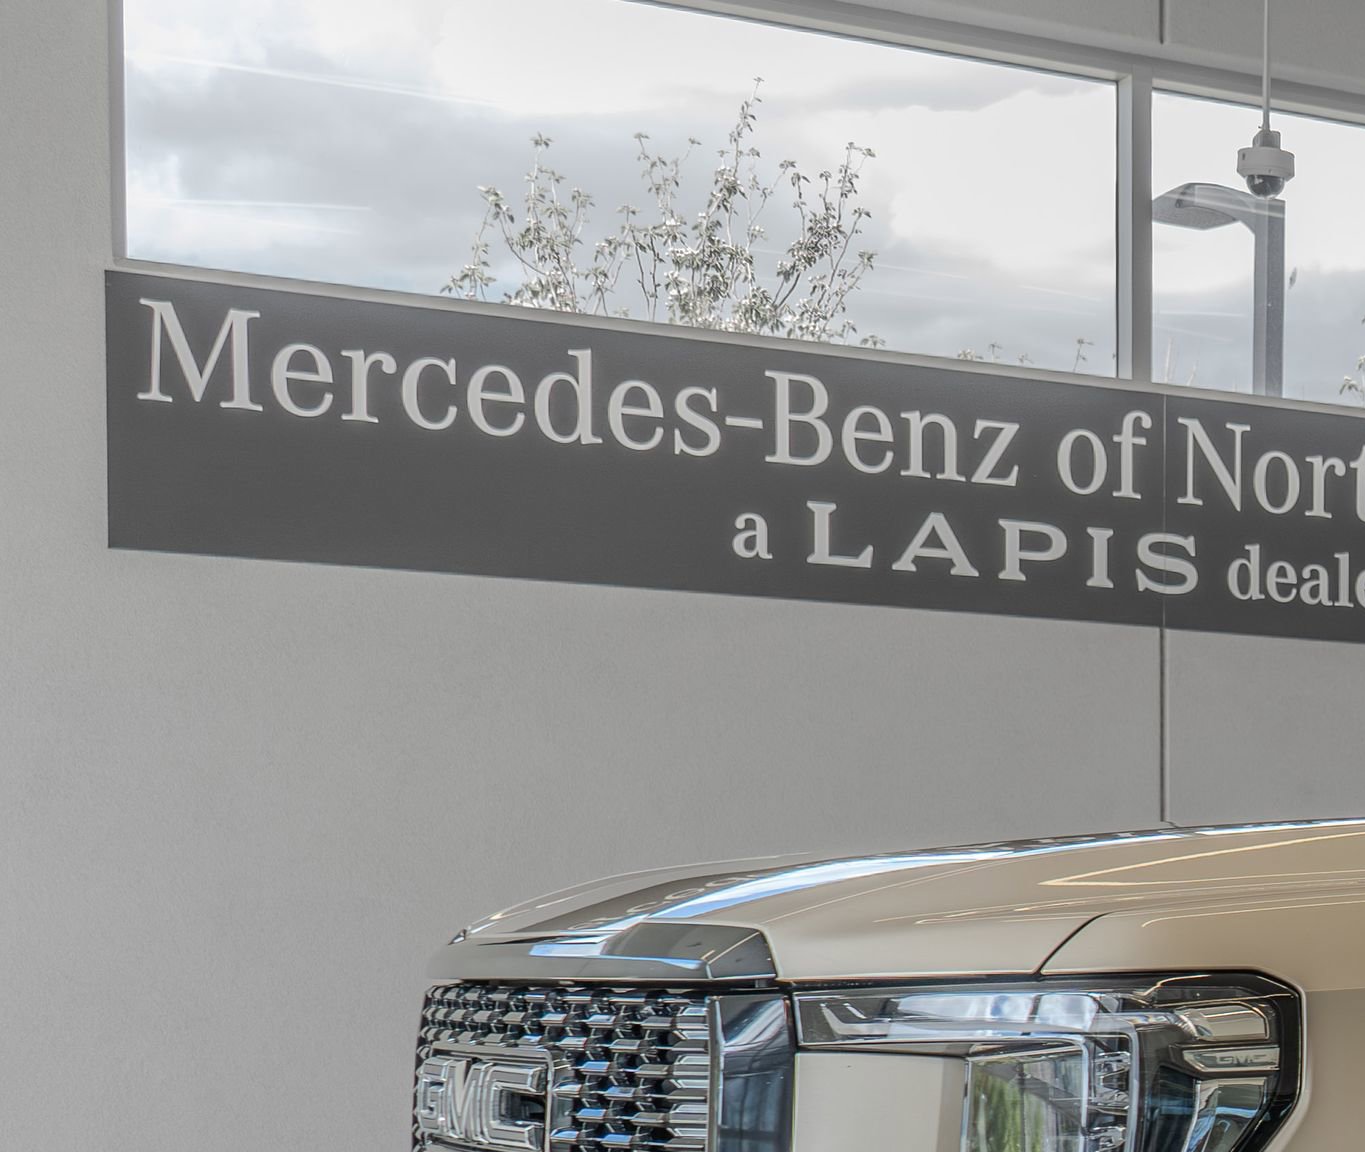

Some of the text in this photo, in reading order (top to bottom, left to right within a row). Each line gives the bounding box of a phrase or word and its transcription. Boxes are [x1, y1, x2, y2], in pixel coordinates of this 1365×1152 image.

[136, 297, 1020, 488] Mercedes-Benz
[1056, 410, 1153, 500] of
[732, 512, 773, 561] a
[806, 501, 1199, 596] LAPIS
[417, 1055, 547, 1152] GMC
